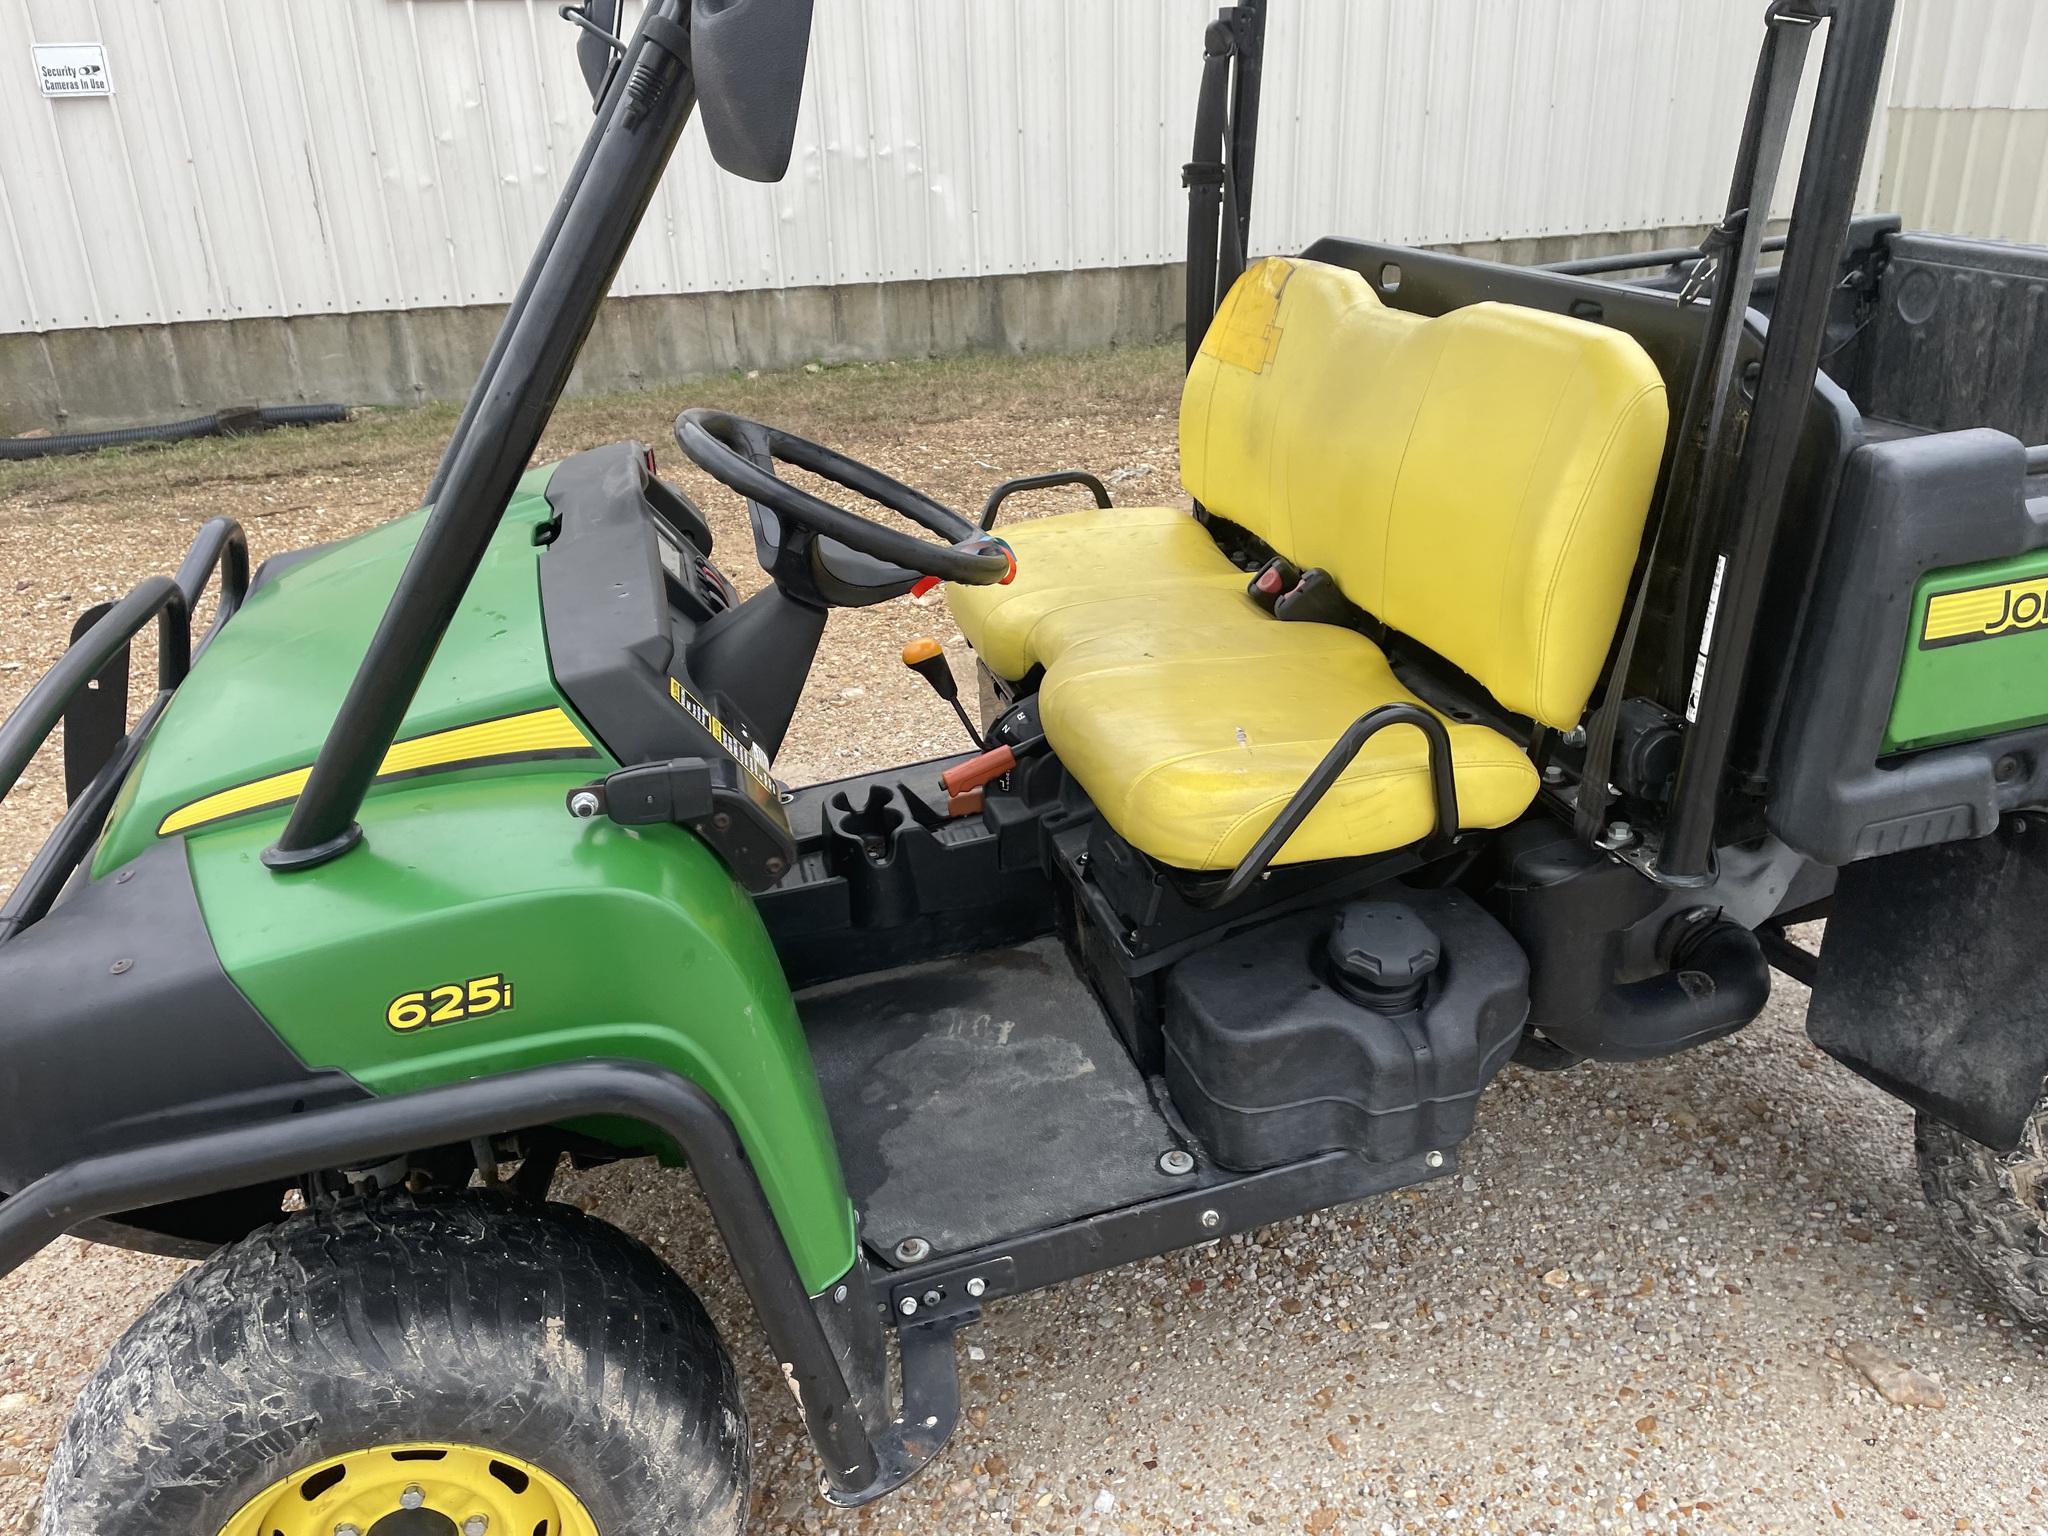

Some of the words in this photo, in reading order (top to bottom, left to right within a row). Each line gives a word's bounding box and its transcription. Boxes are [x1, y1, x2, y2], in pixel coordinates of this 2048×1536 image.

[41, 65, 76, 78] Security
[44, 79, 79, 90] Cameras
[80, 78, 89, 89] In
[90, 78, 105, 89] Use
[1986, 588, 2048, 630] JO
[1001, 724, 1011, 734] N
[387, 974, 512, 1031] 625i
